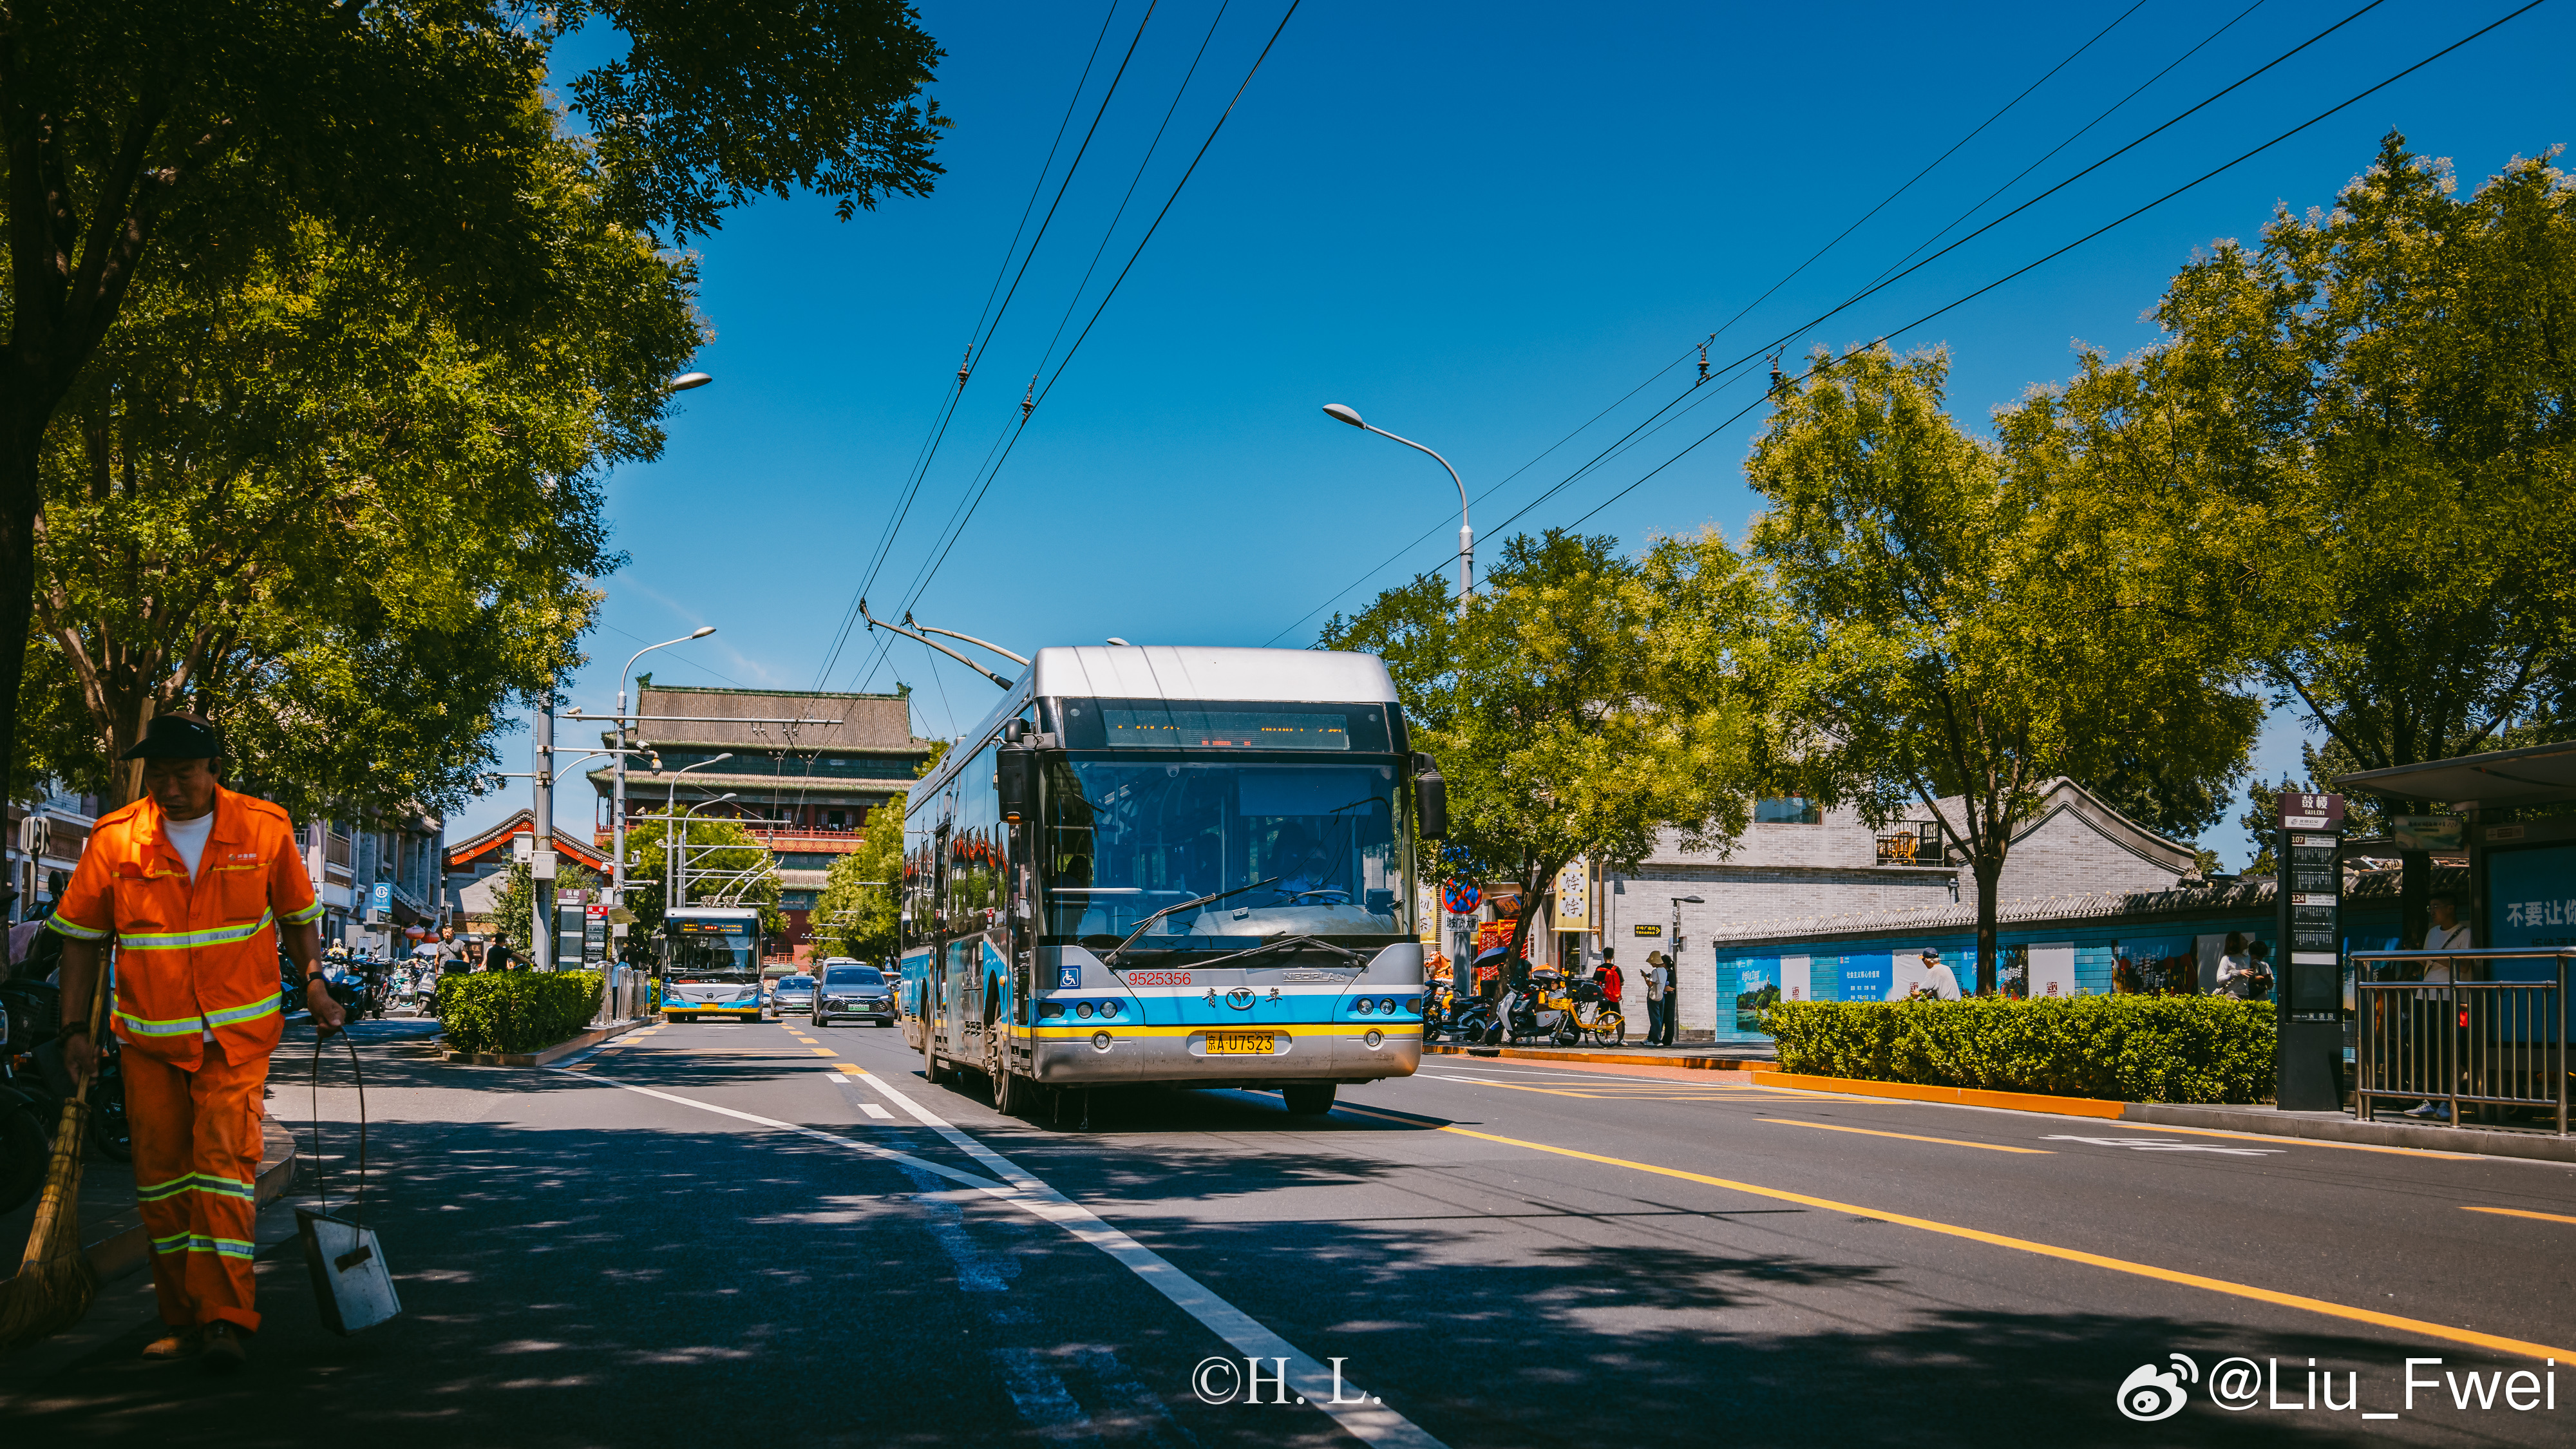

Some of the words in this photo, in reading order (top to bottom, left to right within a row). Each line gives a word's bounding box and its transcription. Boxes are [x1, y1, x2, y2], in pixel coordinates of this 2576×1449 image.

[2302, 795, 2327, 809] 鼓楼
[2506, 899, 2576, 927] 不要让你
[1446, 916, 1477, 929] 地安门外大街
[1128, 972, 1191, 986] 9525356
[1283, 972, 1346, 981] NEOPLAN
[1846, 970, 1880, 979] 社会主义核心价值观
